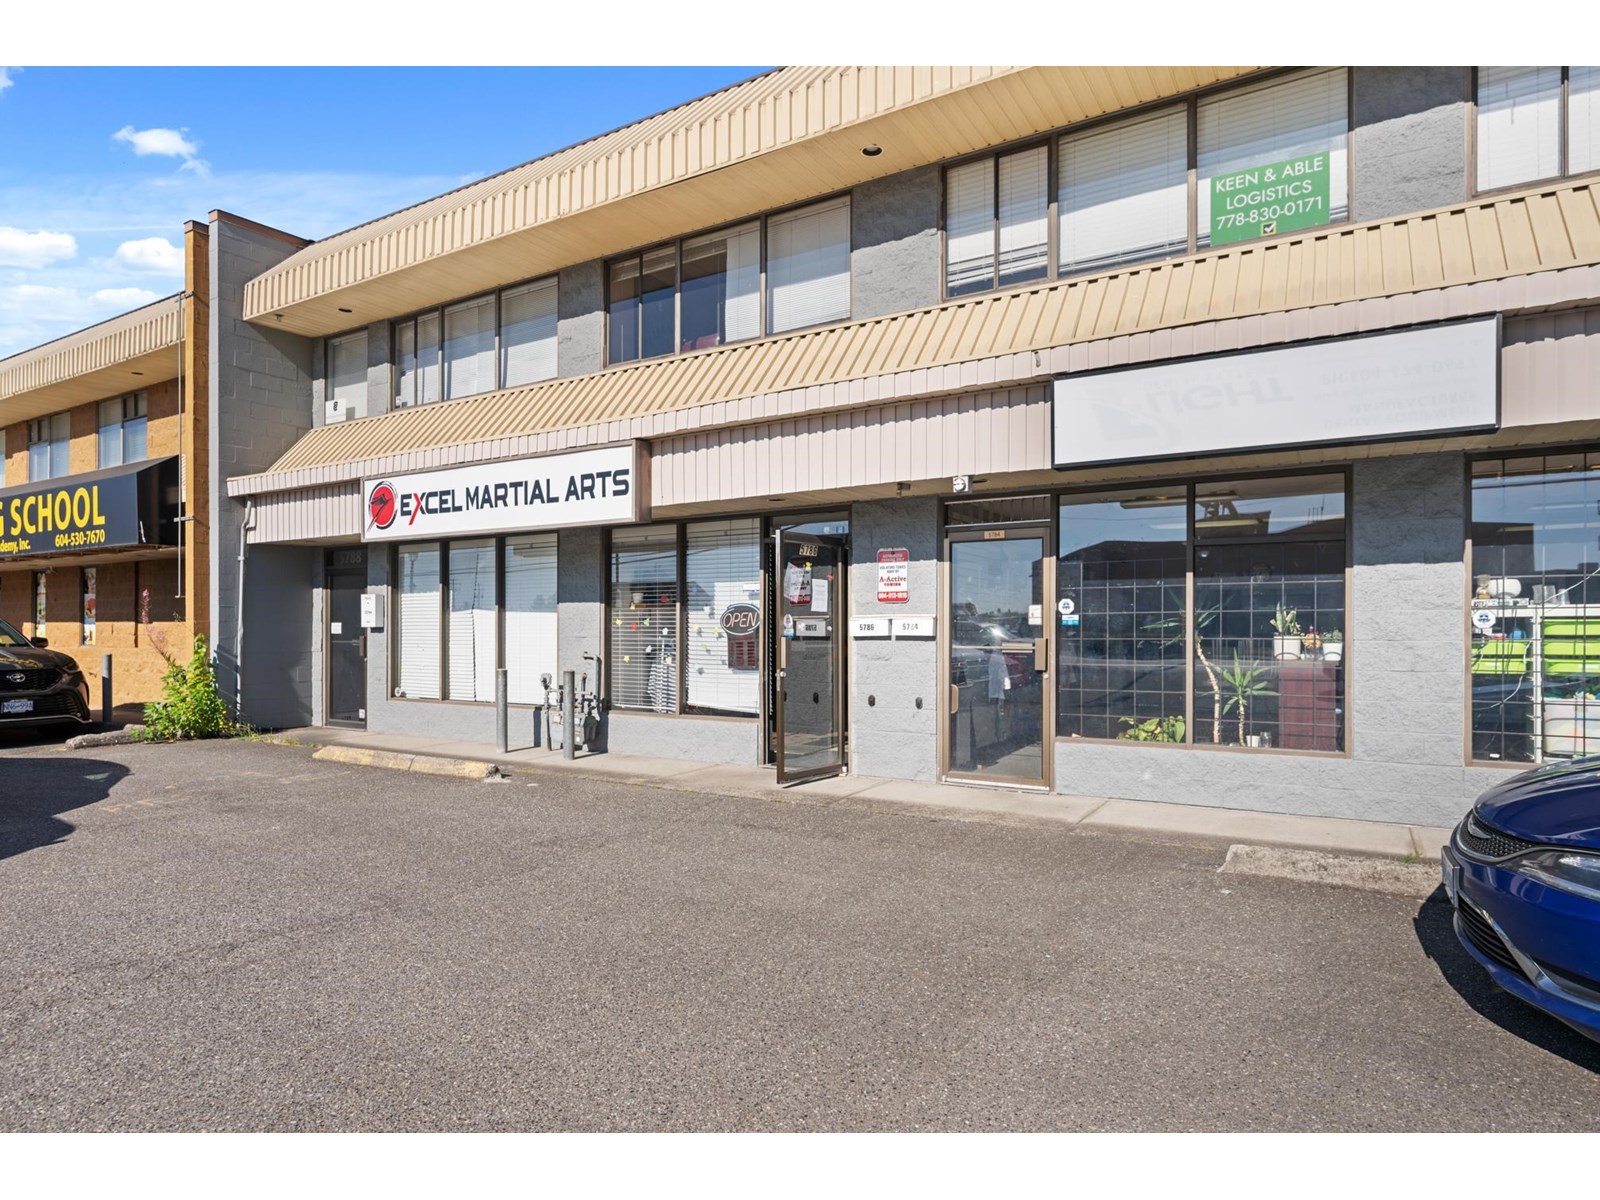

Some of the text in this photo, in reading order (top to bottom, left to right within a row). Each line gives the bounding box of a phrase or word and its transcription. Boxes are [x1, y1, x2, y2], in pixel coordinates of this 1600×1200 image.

[1216, 157, 1323, 193] KEEN & ABLE
[1226, 180, 1312, 210] LOGISTICS
[1216, 196, 1322, 230] 778-830-0171
[400, 468, 630, 525] EXCEL MARTIAL ARTS
[10, 485, 106, 536] SCHOOL
[0, 539, 18, 555] demy,
[55, 529, 105, 547] 604-530-7670
[800, 544, 818, 556] 5786
[723, 612, 757, 628] OPEN
[859, 623, 875, 631] 5786
